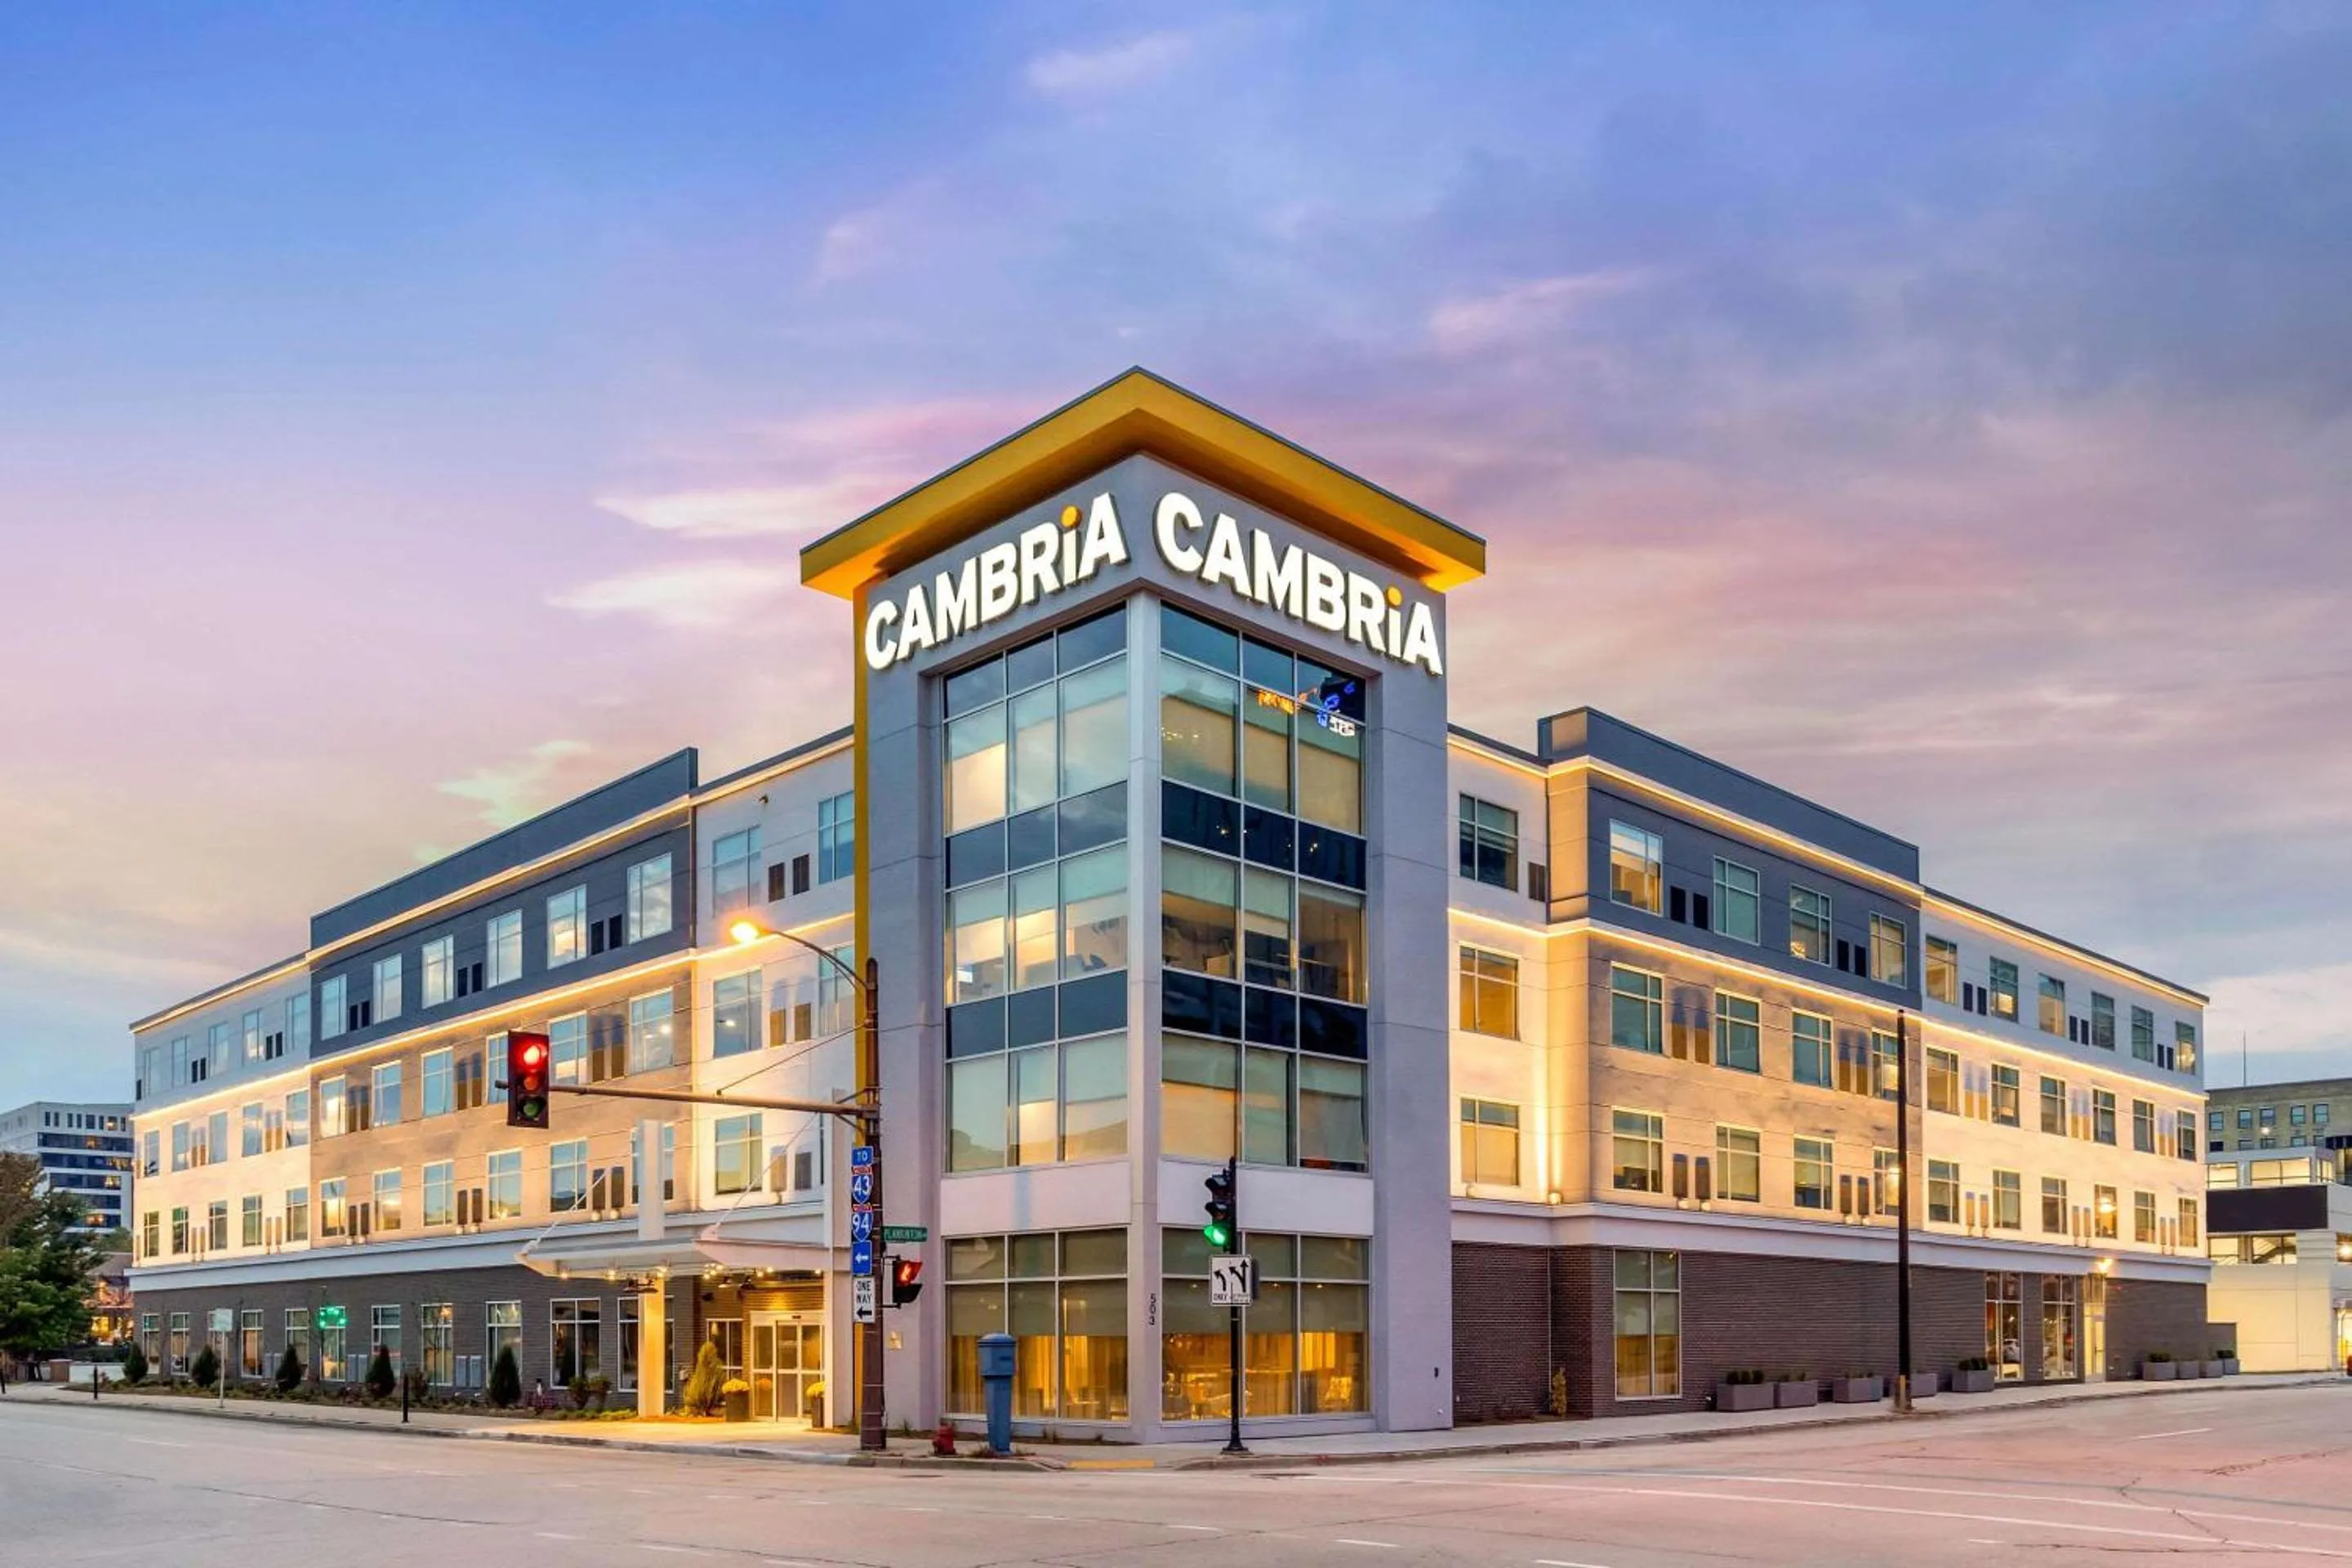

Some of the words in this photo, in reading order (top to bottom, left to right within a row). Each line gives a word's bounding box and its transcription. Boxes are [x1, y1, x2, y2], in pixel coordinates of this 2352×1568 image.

[857, 1151, 867, 1161] TO
[854, 1175, 871, 1196] 43
[853, 1214, 870, 1235] 94
[856, 1281, 871, 1290] ONE
[857, 1294, 872, 1304] WAY
[1214, 1293, 1228, 1301] ONLY
